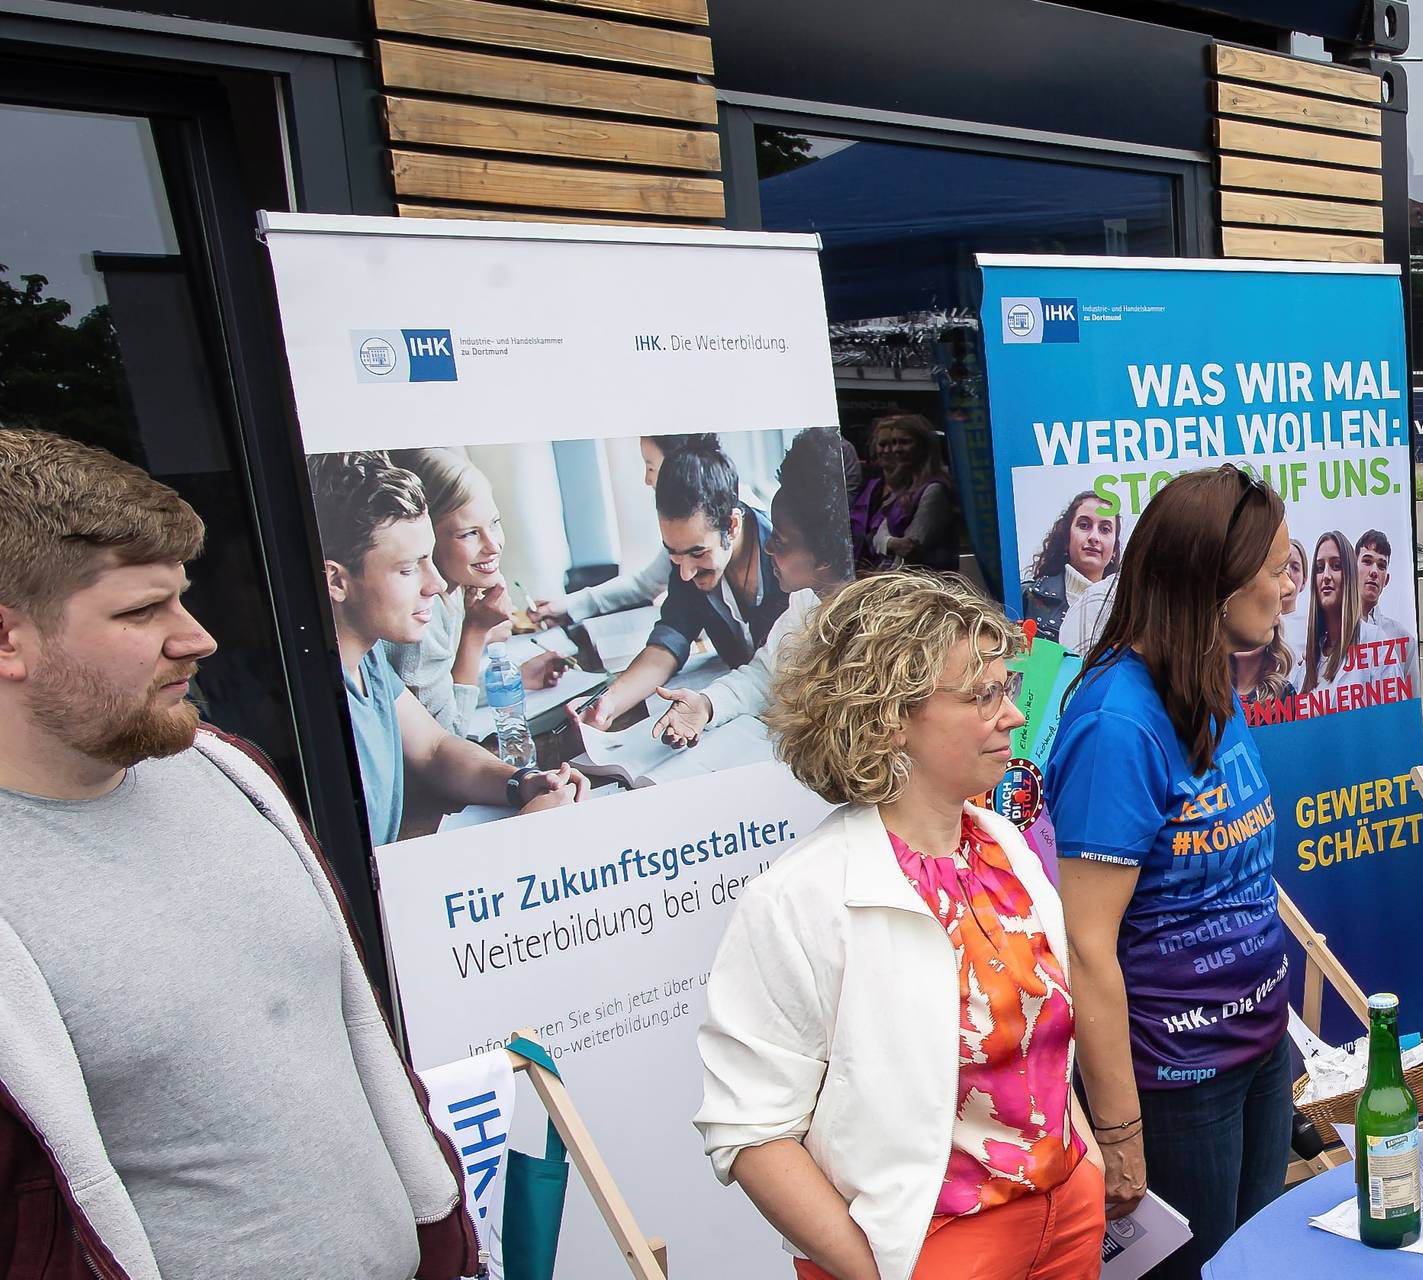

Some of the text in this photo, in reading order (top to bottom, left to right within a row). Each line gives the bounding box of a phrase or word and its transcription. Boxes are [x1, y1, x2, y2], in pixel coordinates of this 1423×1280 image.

[1045, 304, 1076, 321] IHK
[1123, 305, 1165, 313] Handelskammer
[409, 337, 451, 357] IHK
[459, 336, 564, 346] Industrie- und Handelskammer
[471, 347, 508, 356] Dortmund
[634, 334, 789, 353] IHK. Die Weiterbildung.
[1127, 360, 1401, 408] WAS WIR MAL
[1032, 408, 1401, 467] WERDEN WOLLEN:
[1319, 457, 1401, 501] UNS.
[1342, 636, 1410, 674] JETZT
[1295, 773, 1420, 829] GEWERT-
[1080, 850, 1139, 867] WEITERBILDUNG
[1297, 813, 1423, 872] SCHÄTZT
[444, 819, 796, 929] Für Zukunftsgestalter.
[451, 901, 654, 979] Weiterbildung
[663, 879, 701, 918] bei
[1158, 914, 1232, 955] macht
[1192, 946, 1236, 975] aus
[568, 1009, 591, 1030] Sie
[595, 997, 624, 1021] sich
[627, 986, 660, 1014] jetzt
[663, 976, 695, 997] über
[1162, 1006, 1218, 1034] IHK.
[1222, 997, 1255, 1019] Die
[1157, 1065, 1217, 1084] Kempa
